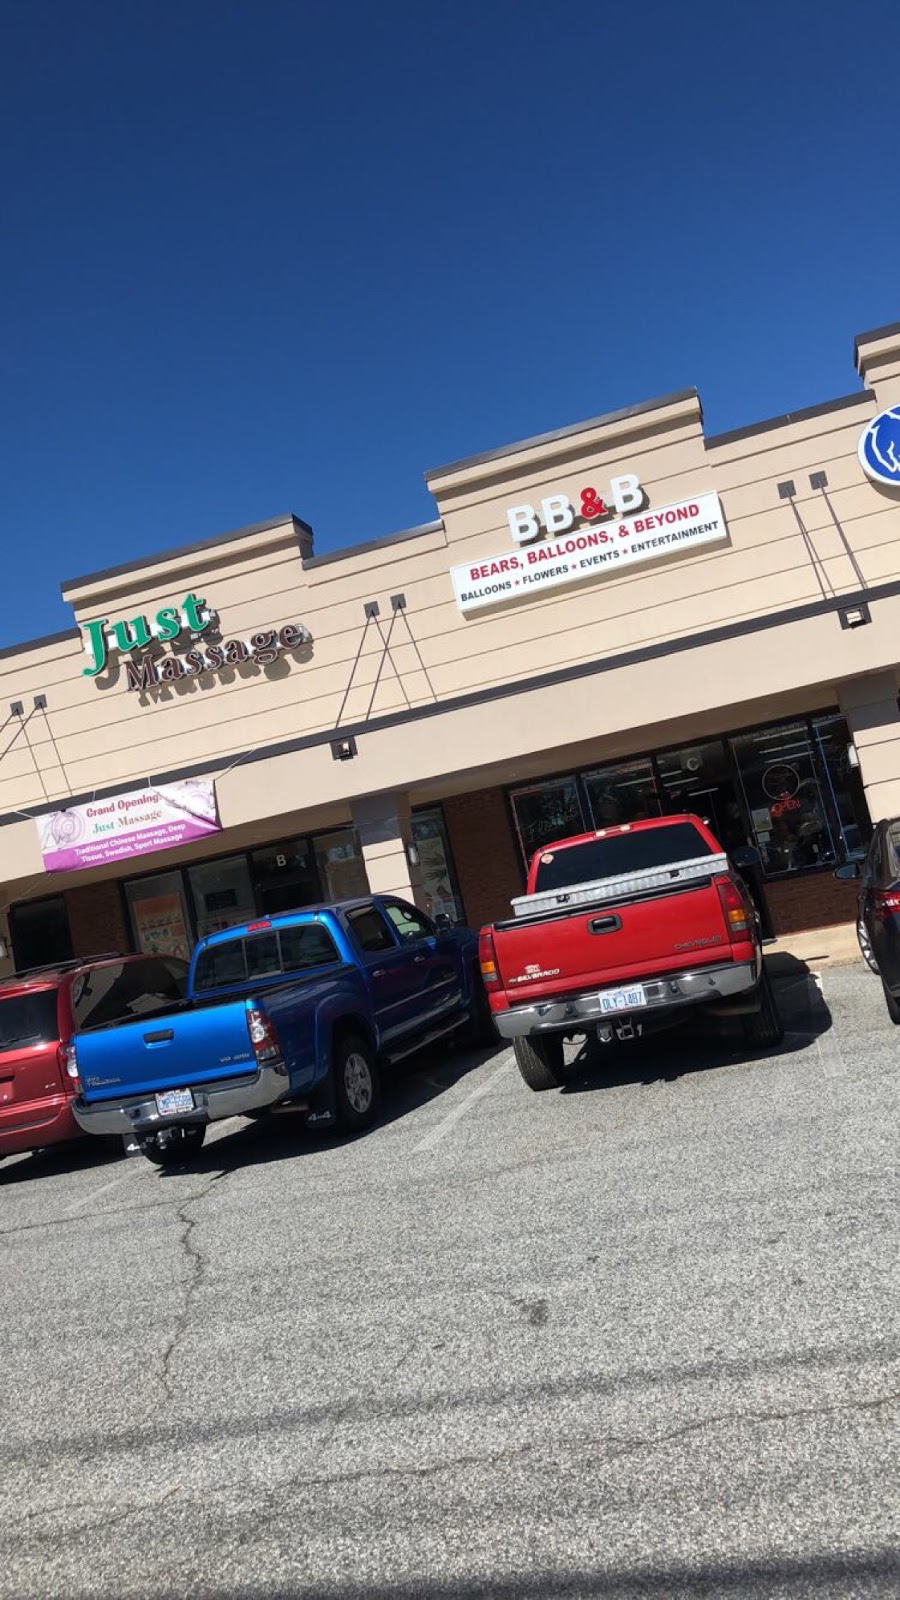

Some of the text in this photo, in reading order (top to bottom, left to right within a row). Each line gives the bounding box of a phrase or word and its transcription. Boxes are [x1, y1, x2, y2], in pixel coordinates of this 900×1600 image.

[470, 504, 699, 581] BEARS, BALLOONS, & BEYOND
[461, 521, 719, 602] BALLOONS FLOWERS EVENTS ENTERTAINMENT
[81, 593, 209, 677] Just
[124, 623, 304, 692] Massage
[86, 802, 115, 818] Grand
[92, 810, 162, 834] Just Massage
[75, 842, 109, 856] Traditional
[110, 836, 135, 847] Chinese
[168, 823, 187, 834] Deep
[134, 839, 153, 851] Sport
[153, 833, 183, 846] Massage
[276, 854, 287, 867] B
